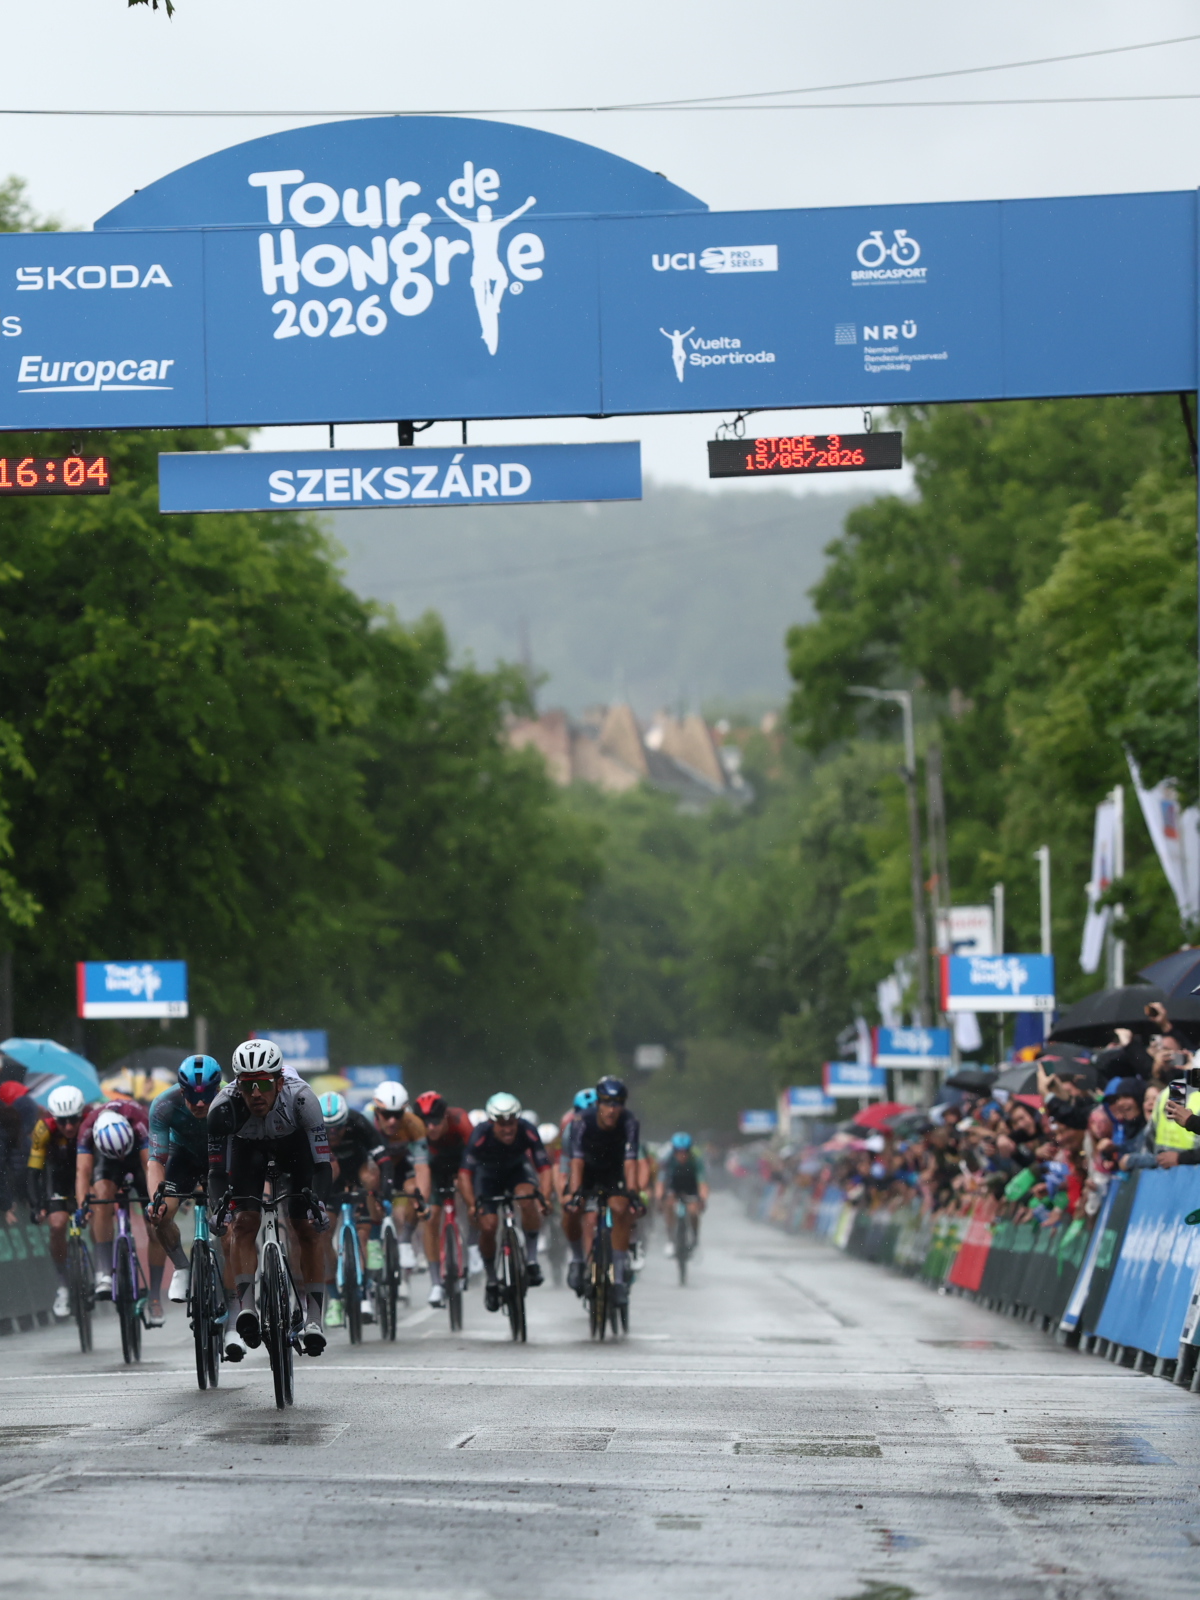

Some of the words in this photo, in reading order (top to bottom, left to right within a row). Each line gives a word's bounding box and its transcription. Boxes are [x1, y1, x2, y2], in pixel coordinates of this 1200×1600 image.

[448, 161, 500, 209] de
[248, 169, 421, 229] Tour
[258, 212, 545, 316] Hongrie
[652, 252, 696, 272] UCI
[730, 251, 751, 259] PRO
[730, 258, 764, 268] SERIES
[851, 267, 928, 281] BRINGASPORT
[271, 294, 388, 340] 2026
[863, 319, 918, 341] NRÜ
[689, 336, 742, 351] Vuelta
[689, 350, 776, 368] Sportiroda
[17, 355, 175, 392] Europcar
[754, 434, 816, 454] STAGE
[826, 433, 841, 451] 3
[745, 448, 867, 471] 15/05/2026
[269, 453, 532, 503] SZEKSZÁRD
